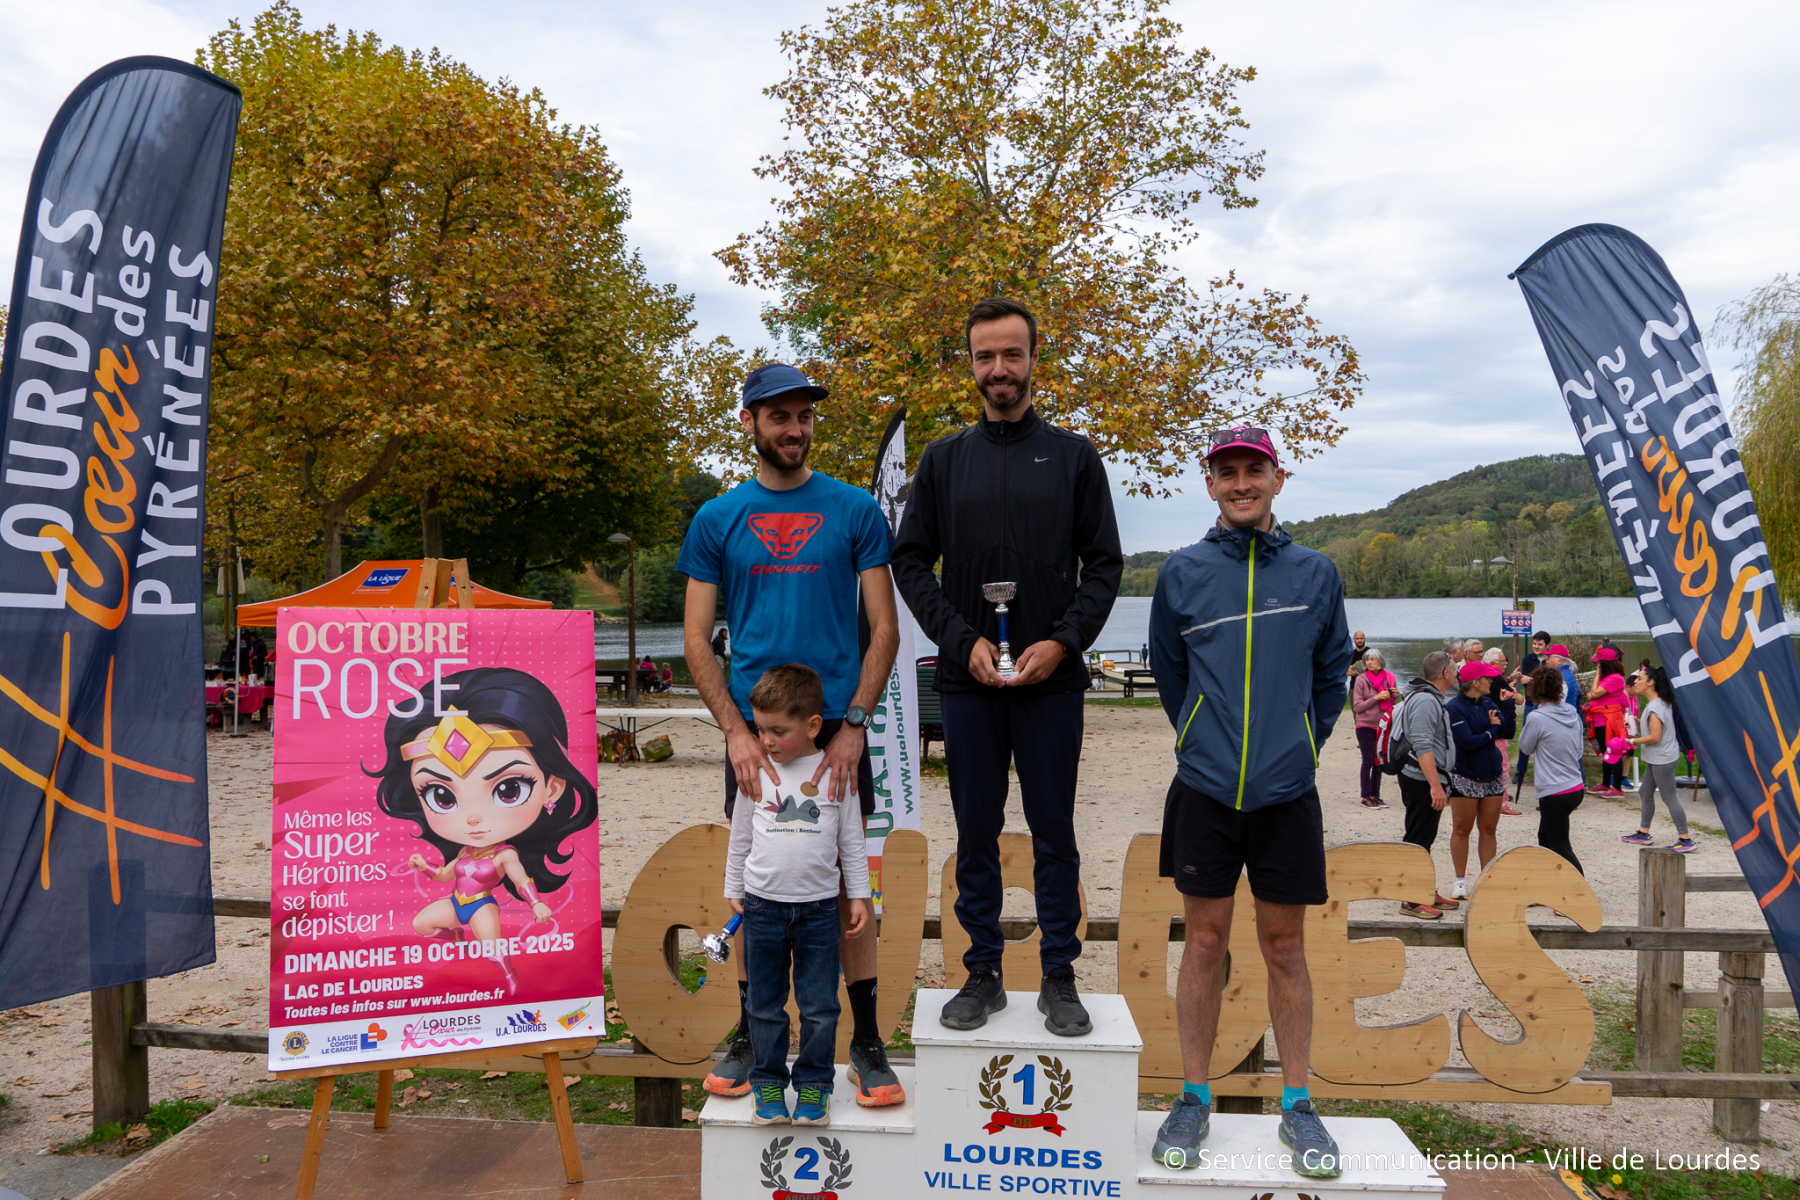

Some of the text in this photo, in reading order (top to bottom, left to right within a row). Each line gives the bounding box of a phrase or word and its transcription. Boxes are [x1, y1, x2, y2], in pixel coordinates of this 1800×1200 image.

[97, 225, 155, 337] des
[0, 197, 103, 609] LOURDES
[132, 244, 213, 615] PYRÉNÉES
[749, 564, 821, 576] DYNAFIT
[287, 622, 468, 654] OCTOBRE
[293, 657, 469, 719] ROSE
[284, 810, 372, 829] Même les
[284, 831, 380, 863] Super
[283, 861, 387, 886] Héroïnes
[282, 890, 348, 911] se font
[282, 910, 394, 941] dépister !
[284, 933, 575, 974] DIMANCHE 19 OCTOBRE 2025
[284, 975, 424, 1000] LAC DE LOURDES
[284, 988, 505, 1019] Toutes les infos sur www.lourdes.fr
[423, 1015, 481, 1029] LOURDES
[496, 1023, 547, 1036] U.A. LOURDES
[1013, 1064, 1035, 1105] 1
[1011, 1117, 1032, 1127] OR
[794, 1147, 819, 1180] 2
[944, 1143, 1103, 1170] LOURDES
[924, 1171, 1121, 1197] VILLE SPORTIVE
